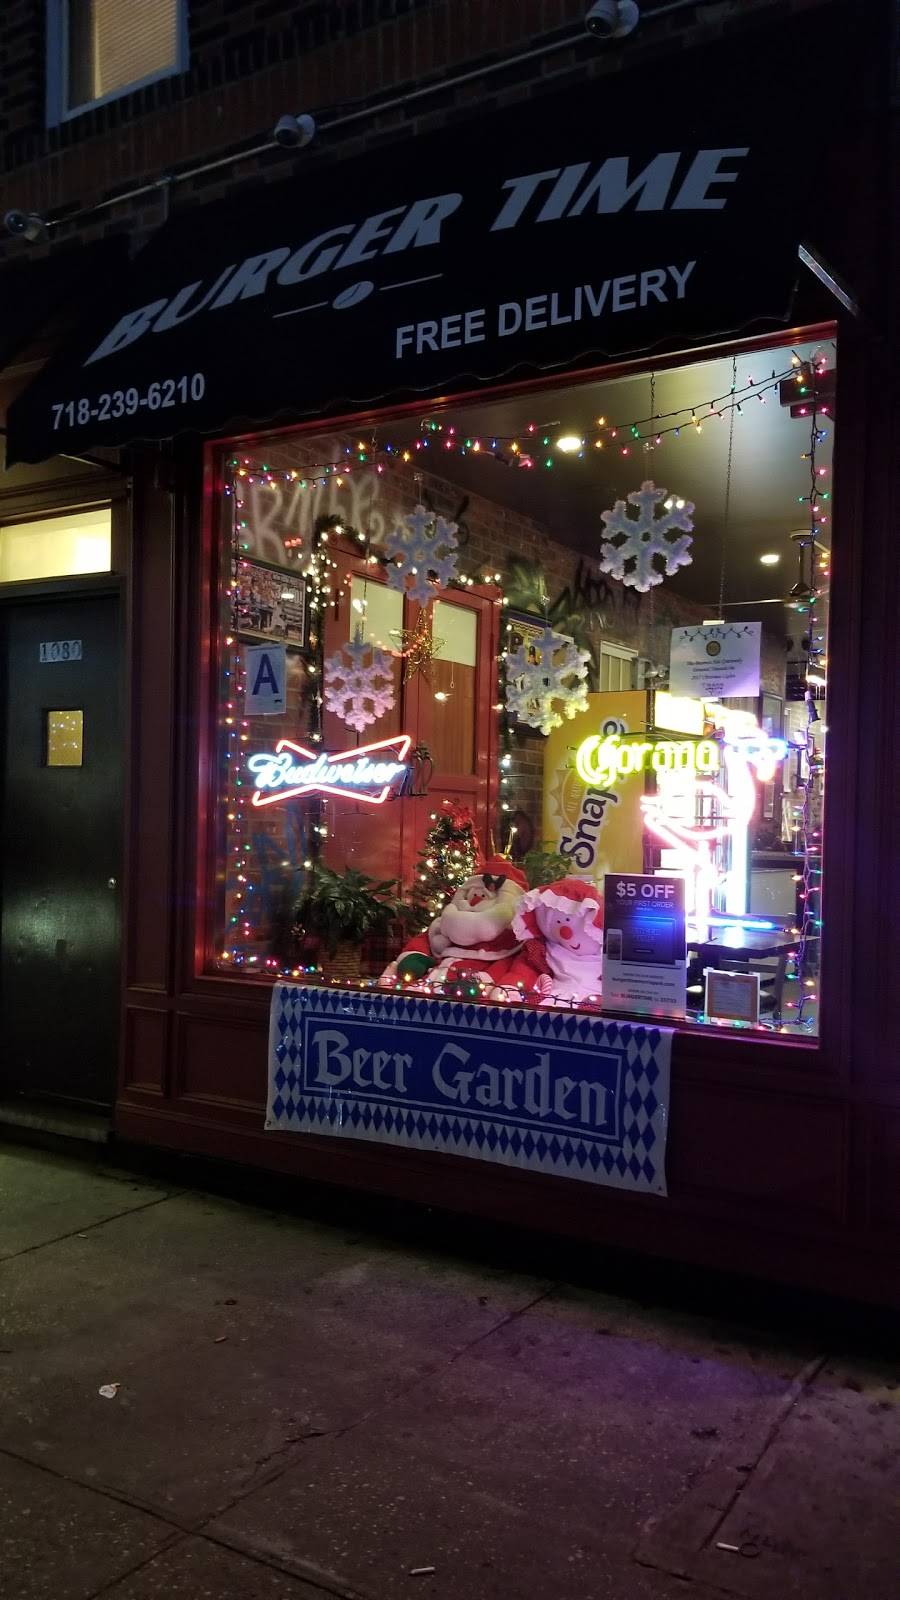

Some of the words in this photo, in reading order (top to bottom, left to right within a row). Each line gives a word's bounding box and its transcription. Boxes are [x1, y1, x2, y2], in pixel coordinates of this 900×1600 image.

[83, 193, 463, 367] BURGER
[490, 147, 750, 232] TIME
[396, 309, 486, 359] FREE
[498, 260, 697, 337] DELIVERY
[52, 373, 206, 430] 718-239-6210
[252, 653, 280, 695] A
[248, 752, 406, 788] Budweiser
[576, 734, 720, 787] Corona
[616, 880, 637, 898] $5
[640, 883, 675, 899] OFF
[652, 901, 674, 909] ORDER
[312, 1029, 414, 1093] Beer
[432, 1042, 608, 1126] Garden
